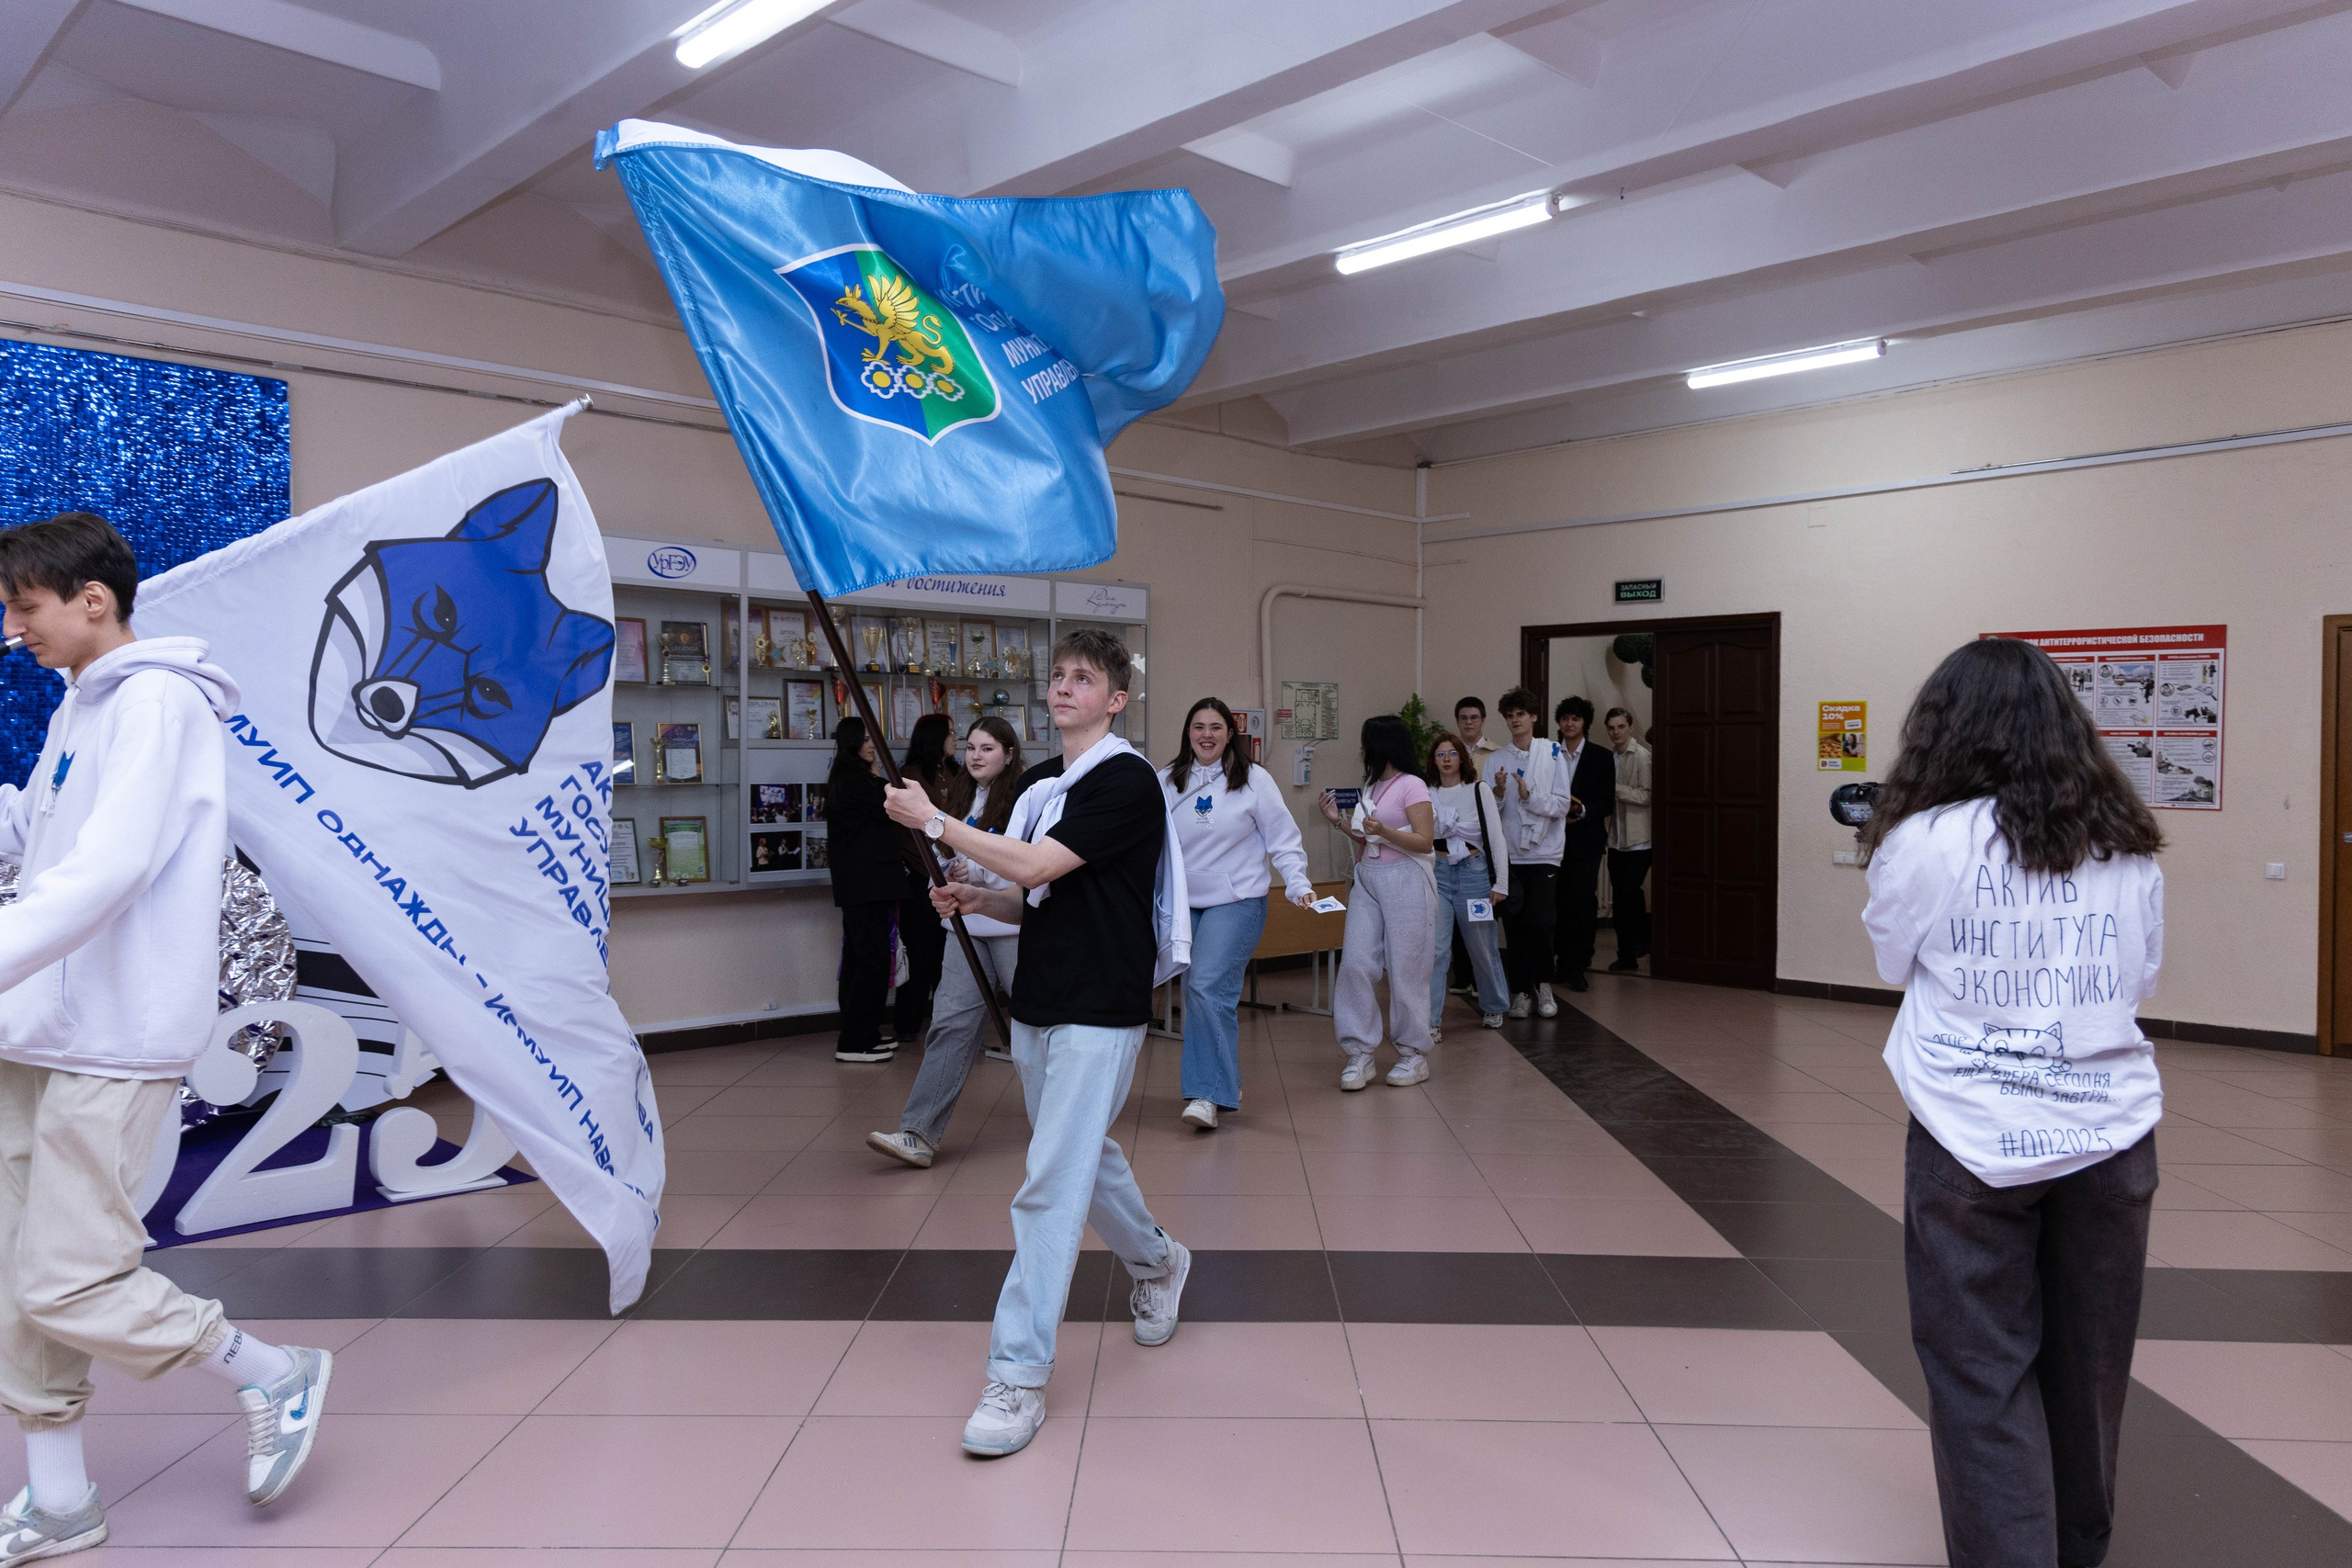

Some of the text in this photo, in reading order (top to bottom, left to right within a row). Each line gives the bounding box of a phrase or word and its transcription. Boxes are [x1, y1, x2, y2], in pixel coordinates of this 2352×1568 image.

[1620, 582, 1657, 591] ЗАПАСНЫЙ
[1620, 590, 1657, 598] ВЫХОД
[2040, 634, 2139, 647] АНТИТЕРРОРИСТИЧЕСКОЙ
[2139, 633, 2204, 644] БЕЗОПАСНОСТИ
[1822, 705, 1860, 713] Скидка
[1975, 863, 2078, 908] АКТИВ
[1951, 913, 2119, 960] ИНСТИТУТА
[1952, 964, 2124, 1008] ЭКОНОМИКИ
[1997, 1126, 2113, 1158] #ДП2025
